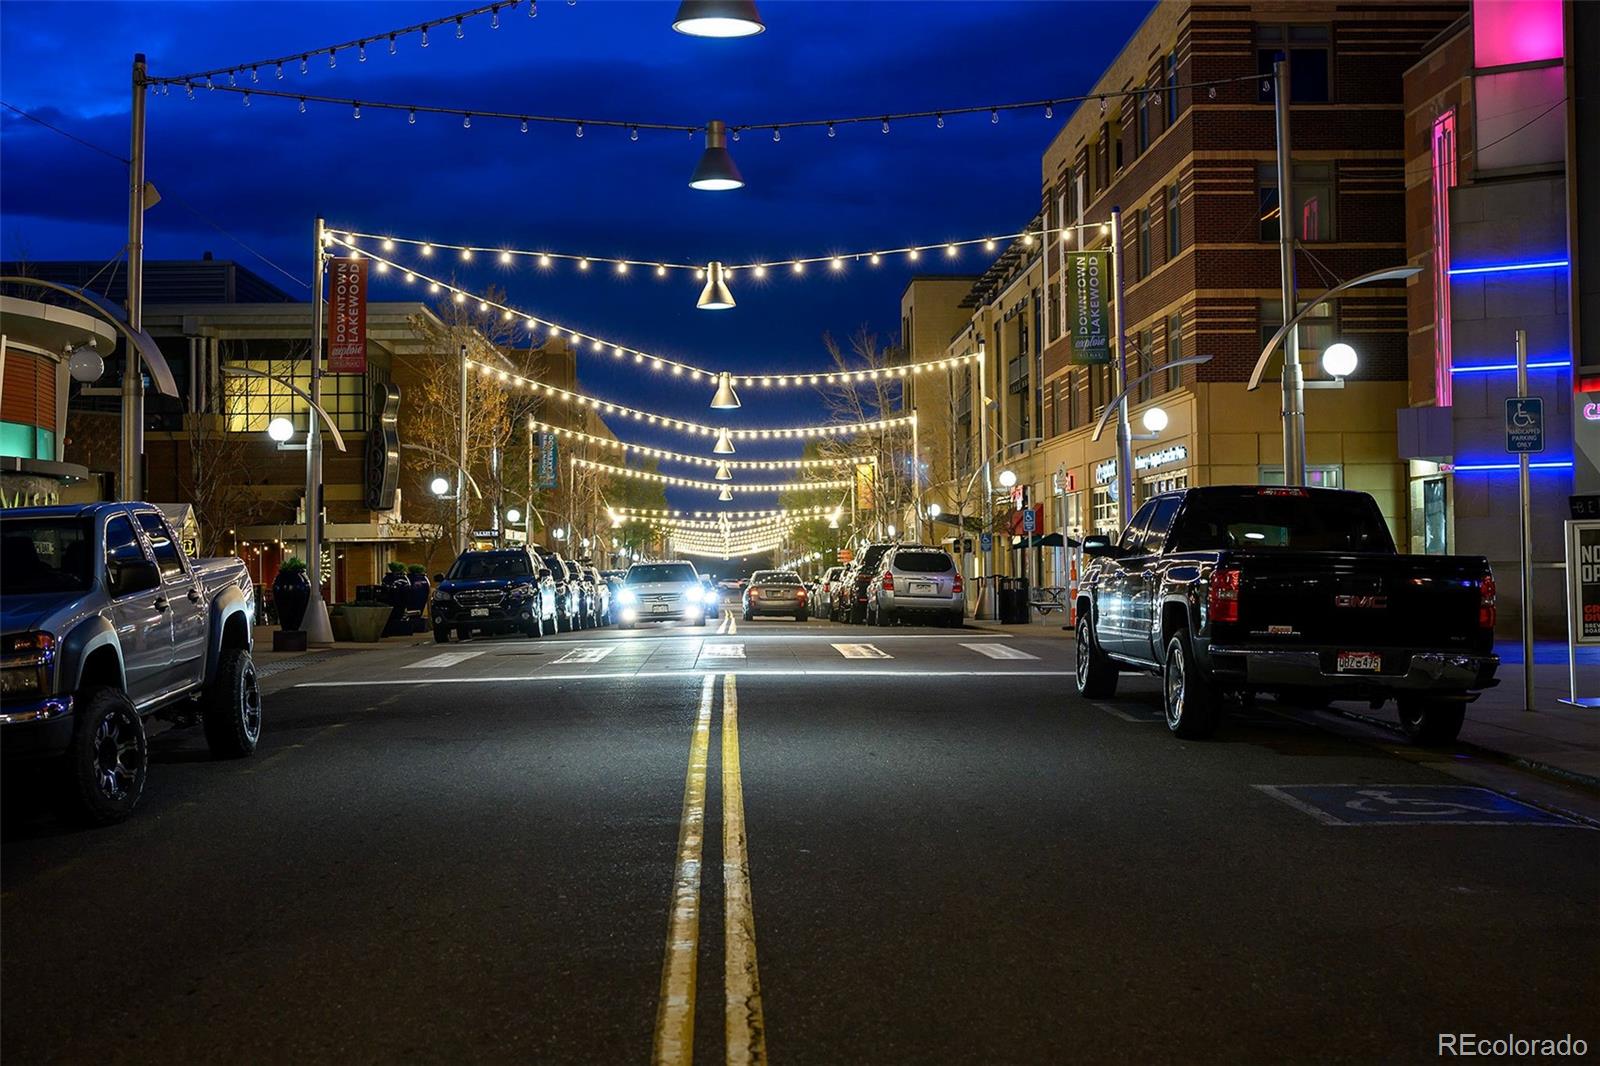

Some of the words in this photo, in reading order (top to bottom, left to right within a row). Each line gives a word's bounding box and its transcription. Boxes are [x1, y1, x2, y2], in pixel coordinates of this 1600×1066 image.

[337, 263, 347, 342] DOWNTOWN
[348, 263, 359, 342] LAKEWOOD
[1077, 256, 1088, 335] DOWNTOWN
[1089, 256, 1101, 335] LAKEWOOD
[1075, 335, 1106, 350] explore
[1335, 594, 1388, 609] GMC
